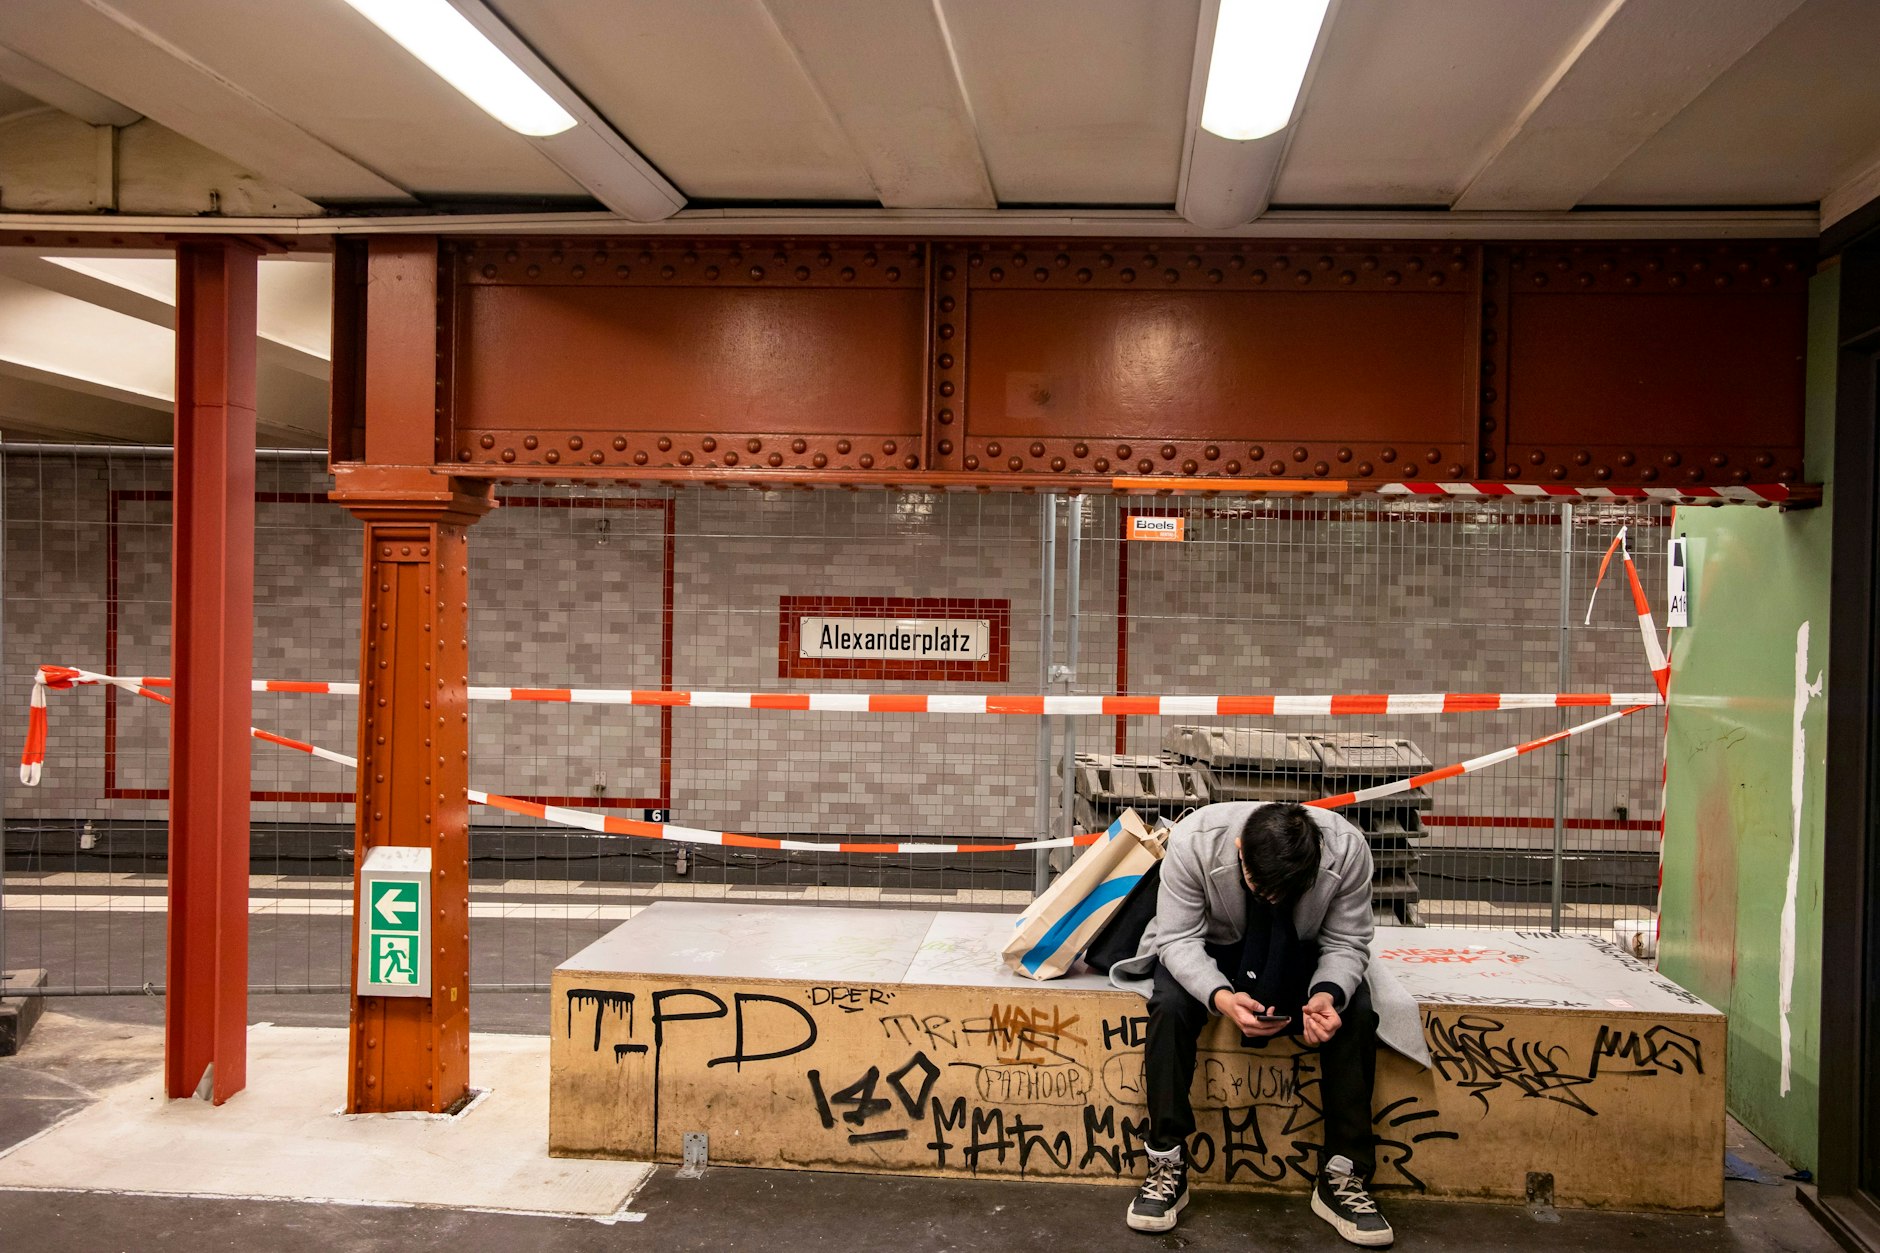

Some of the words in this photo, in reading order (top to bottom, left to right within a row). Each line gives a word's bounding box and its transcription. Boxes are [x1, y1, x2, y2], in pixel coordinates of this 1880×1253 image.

[1136, 520, 1174, 529] Boels
[820, 624, 970, 654] Alexanderplatz
[651, 809, 662, 822] 6
